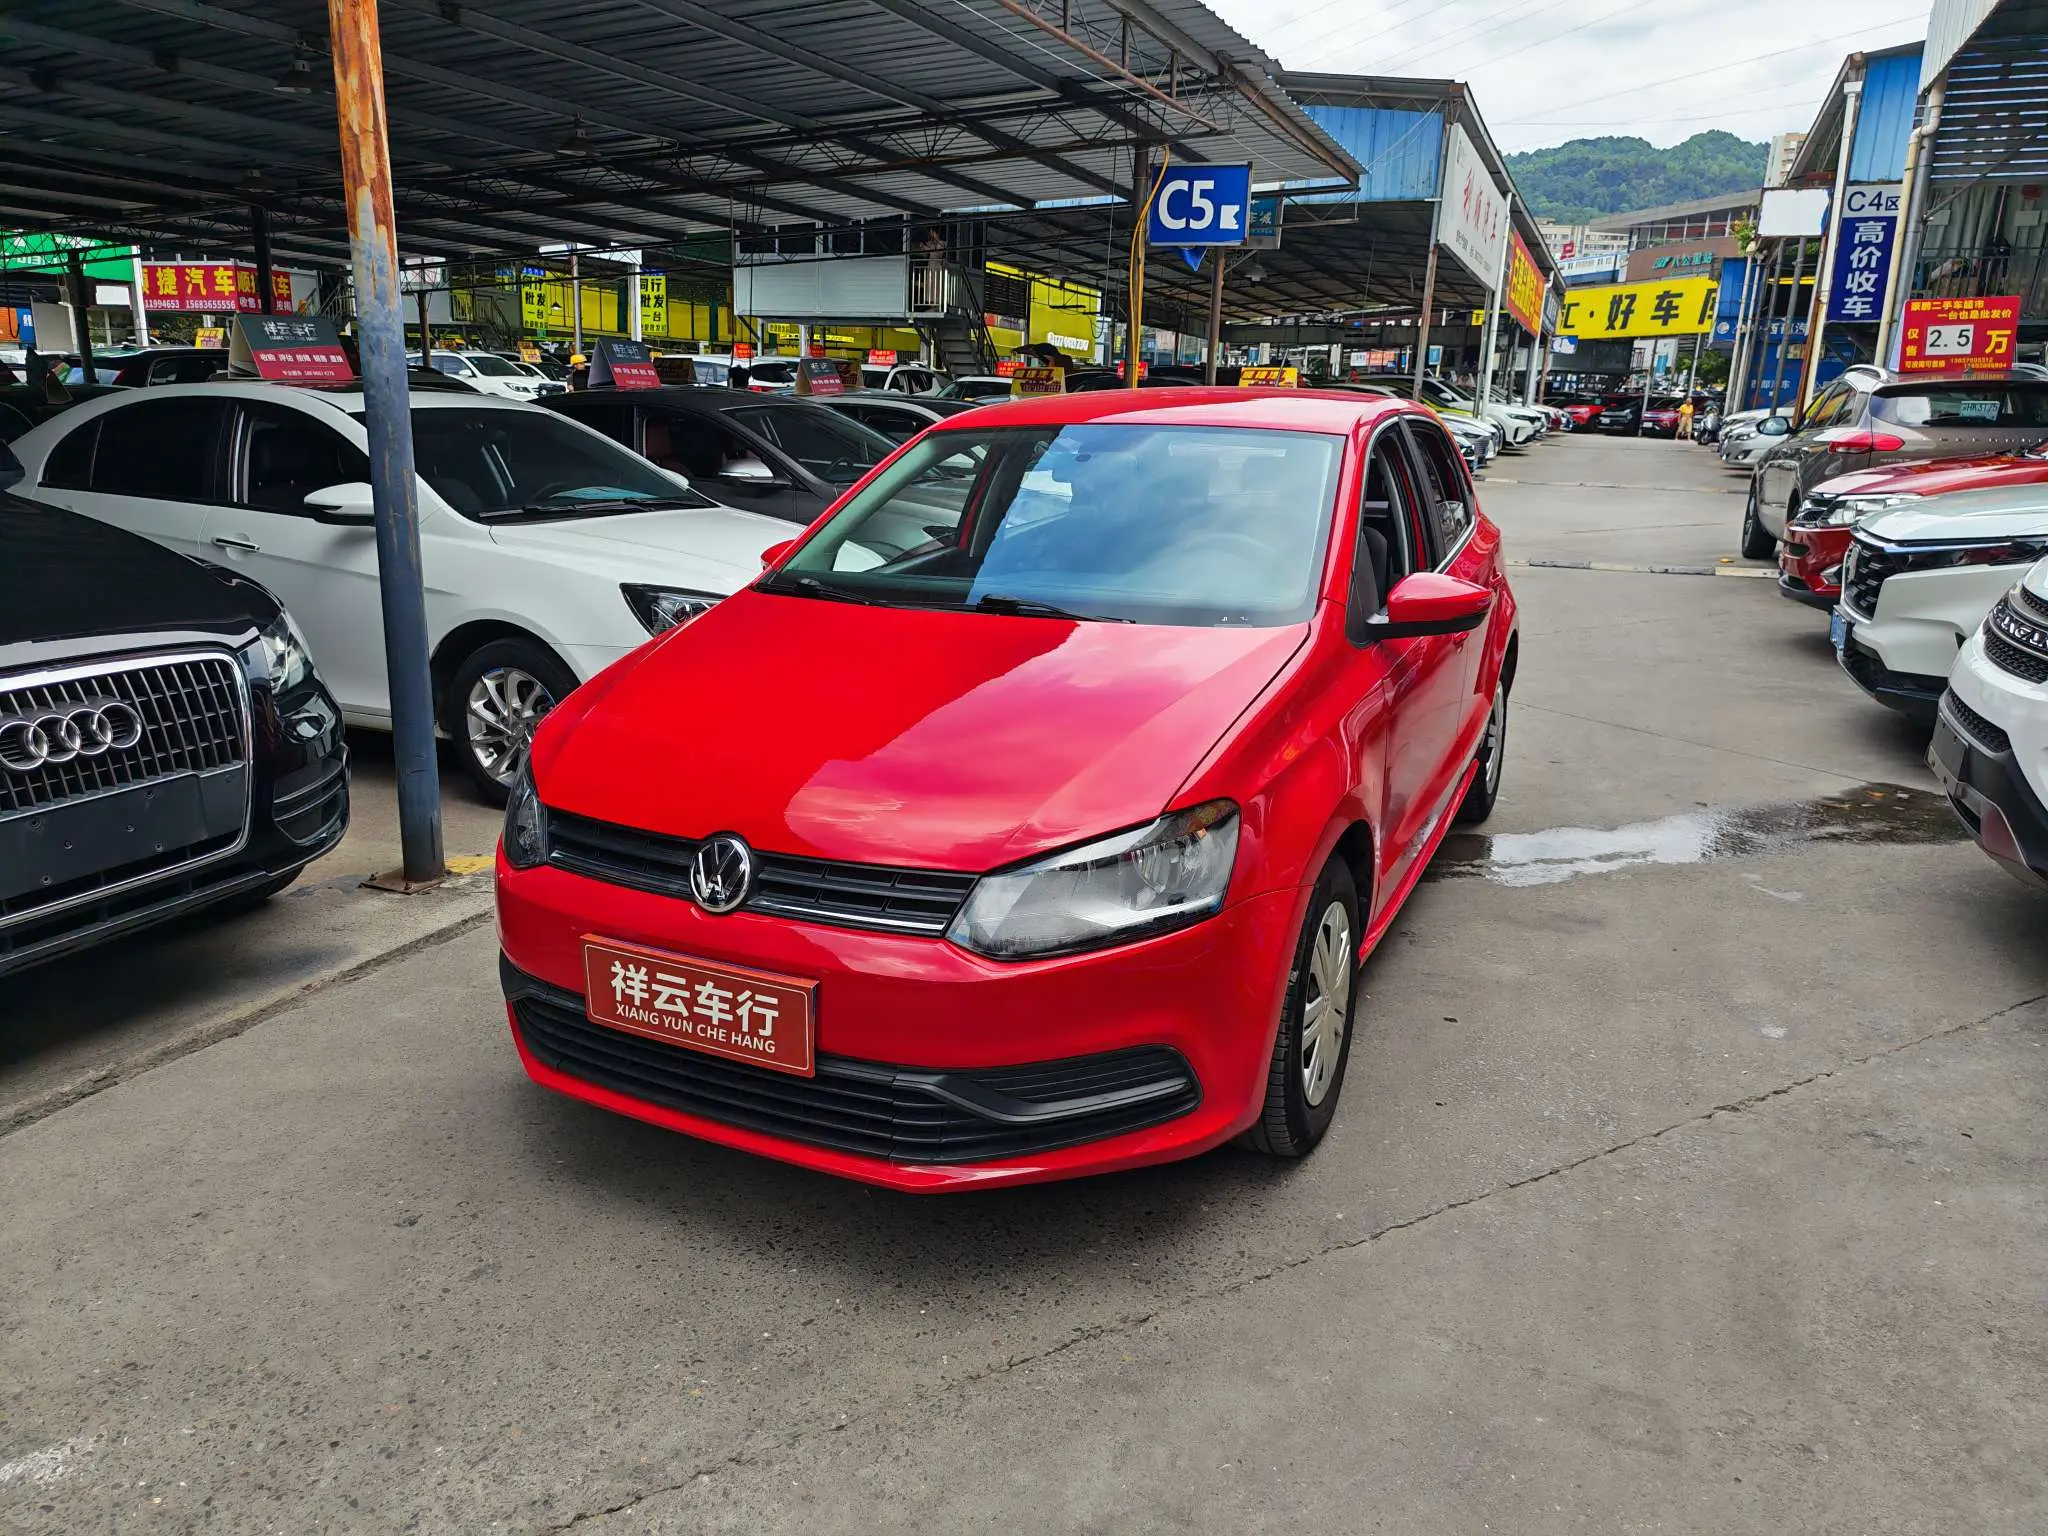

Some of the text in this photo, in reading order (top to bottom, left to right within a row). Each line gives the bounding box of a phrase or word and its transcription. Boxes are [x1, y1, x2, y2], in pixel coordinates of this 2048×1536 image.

[1847, 191, 1901, 213] C4区
[1841, 221, 1887, 318] 高价收车
[525, 292, 546, 308] 批发
[1937, 308, 2012, 320] 一台也是批发价
[262, 320, 318, 337] 祥云车行
[1984, 329, 2012, 355] 万
[610, 960, 779, 1037] 祥云车行
[615, 1002, 776, 1054] XIANG YUN CHE HANG
